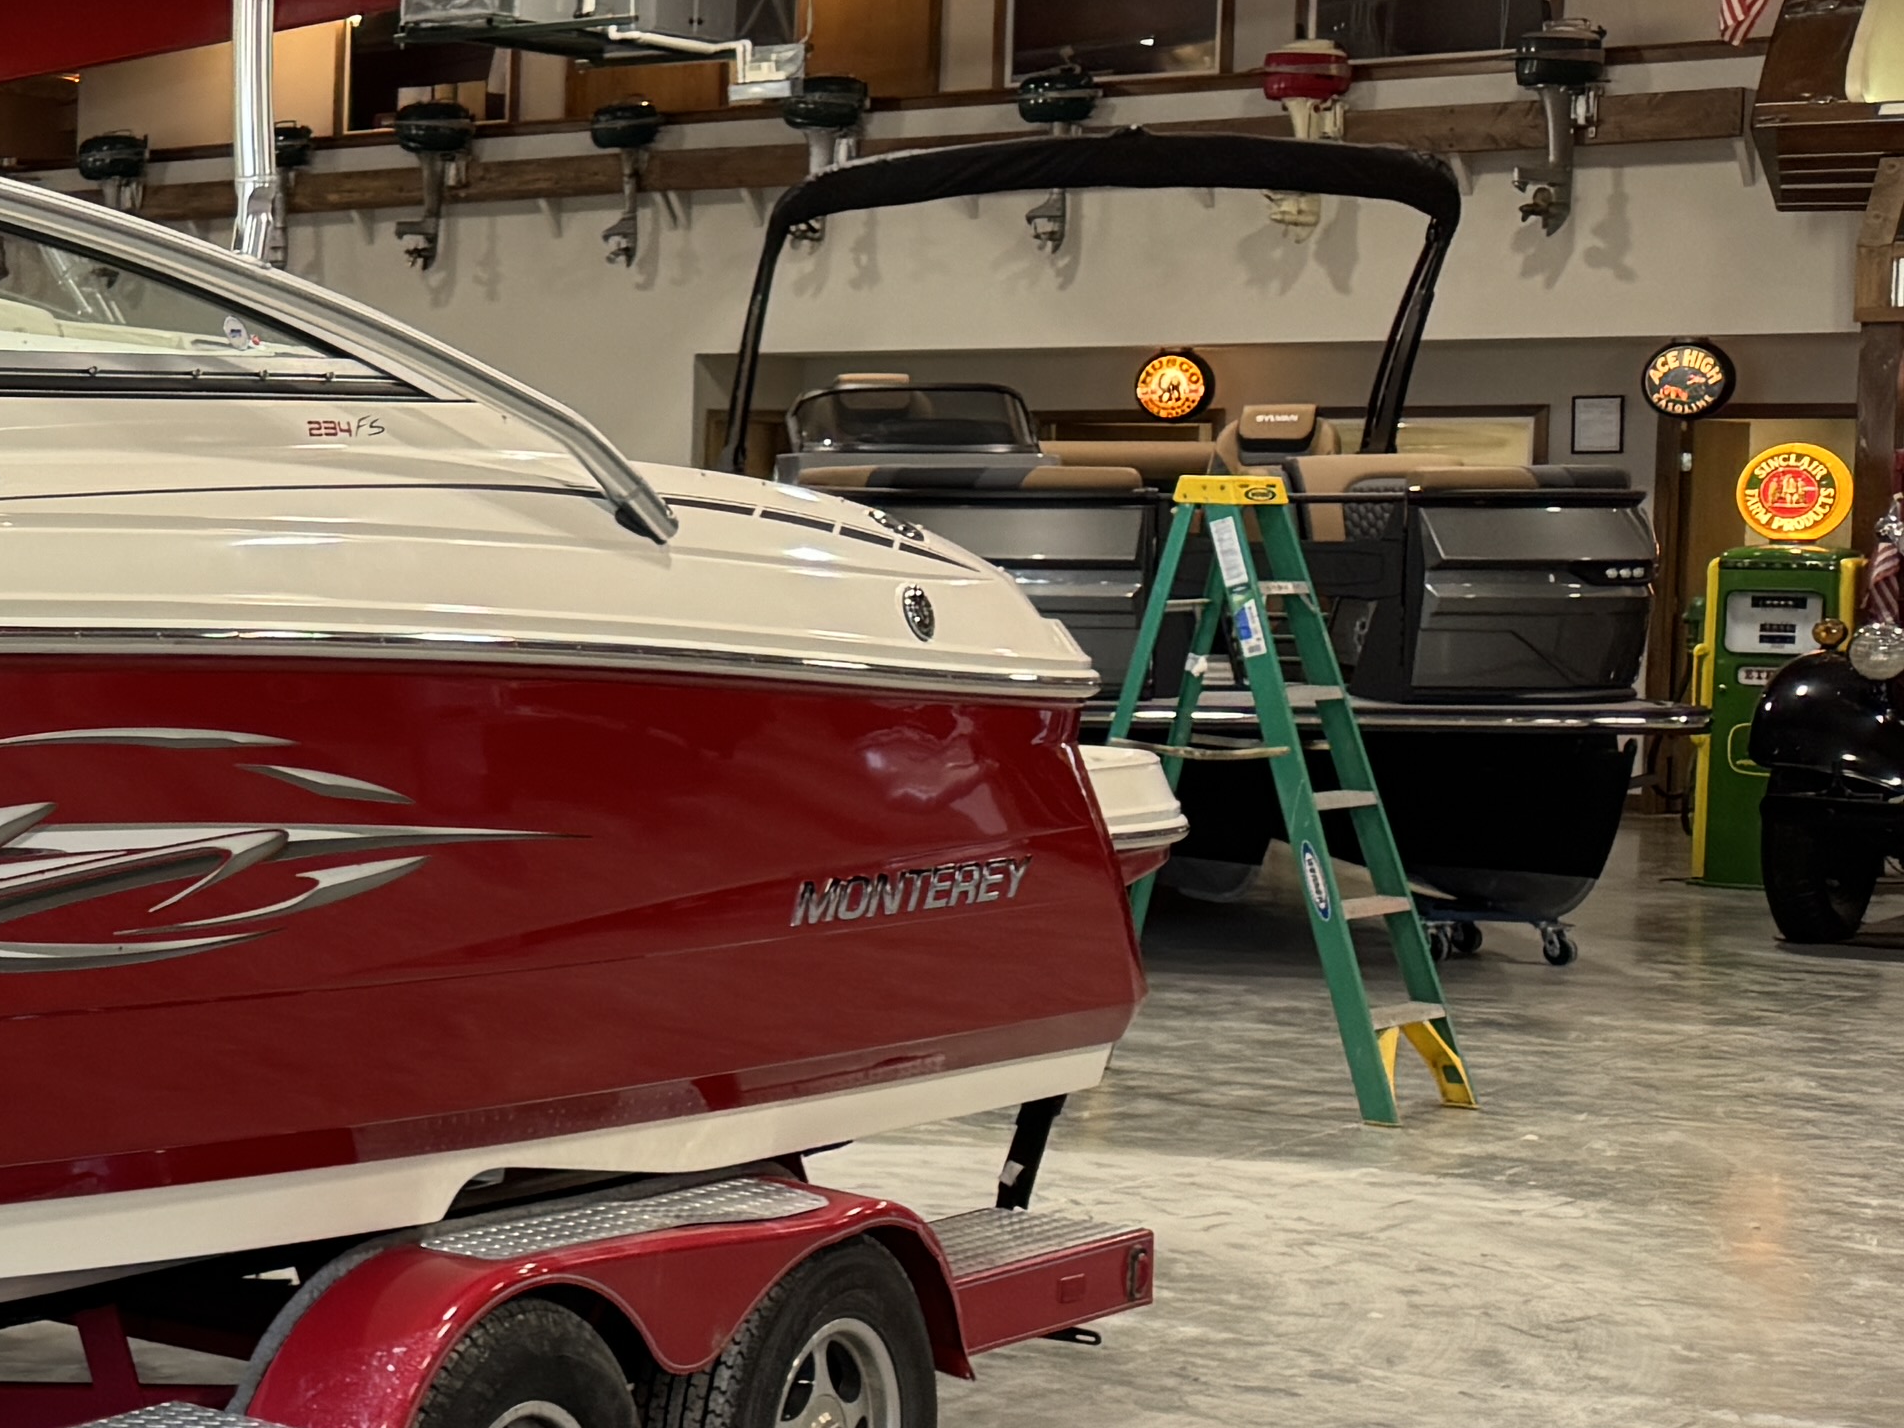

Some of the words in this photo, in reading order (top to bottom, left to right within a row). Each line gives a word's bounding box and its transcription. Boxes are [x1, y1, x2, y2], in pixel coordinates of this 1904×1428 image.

[1649, 351, 1680, 385] ACE
[1682, 349, 1723, 385] HIGH
[1652, 393, 1714, 414] GASOLINE
[307, 421, 352, 437] 234
[355, 415, 385, 436] FS
[1754, 454, 1827, 480] SINCLAIR
[1745, 488, 1772, 524] FARM
[1771, 487, 1834, 531] PRODUCTS
[790, 854, 1032, 927] MONTEREY
